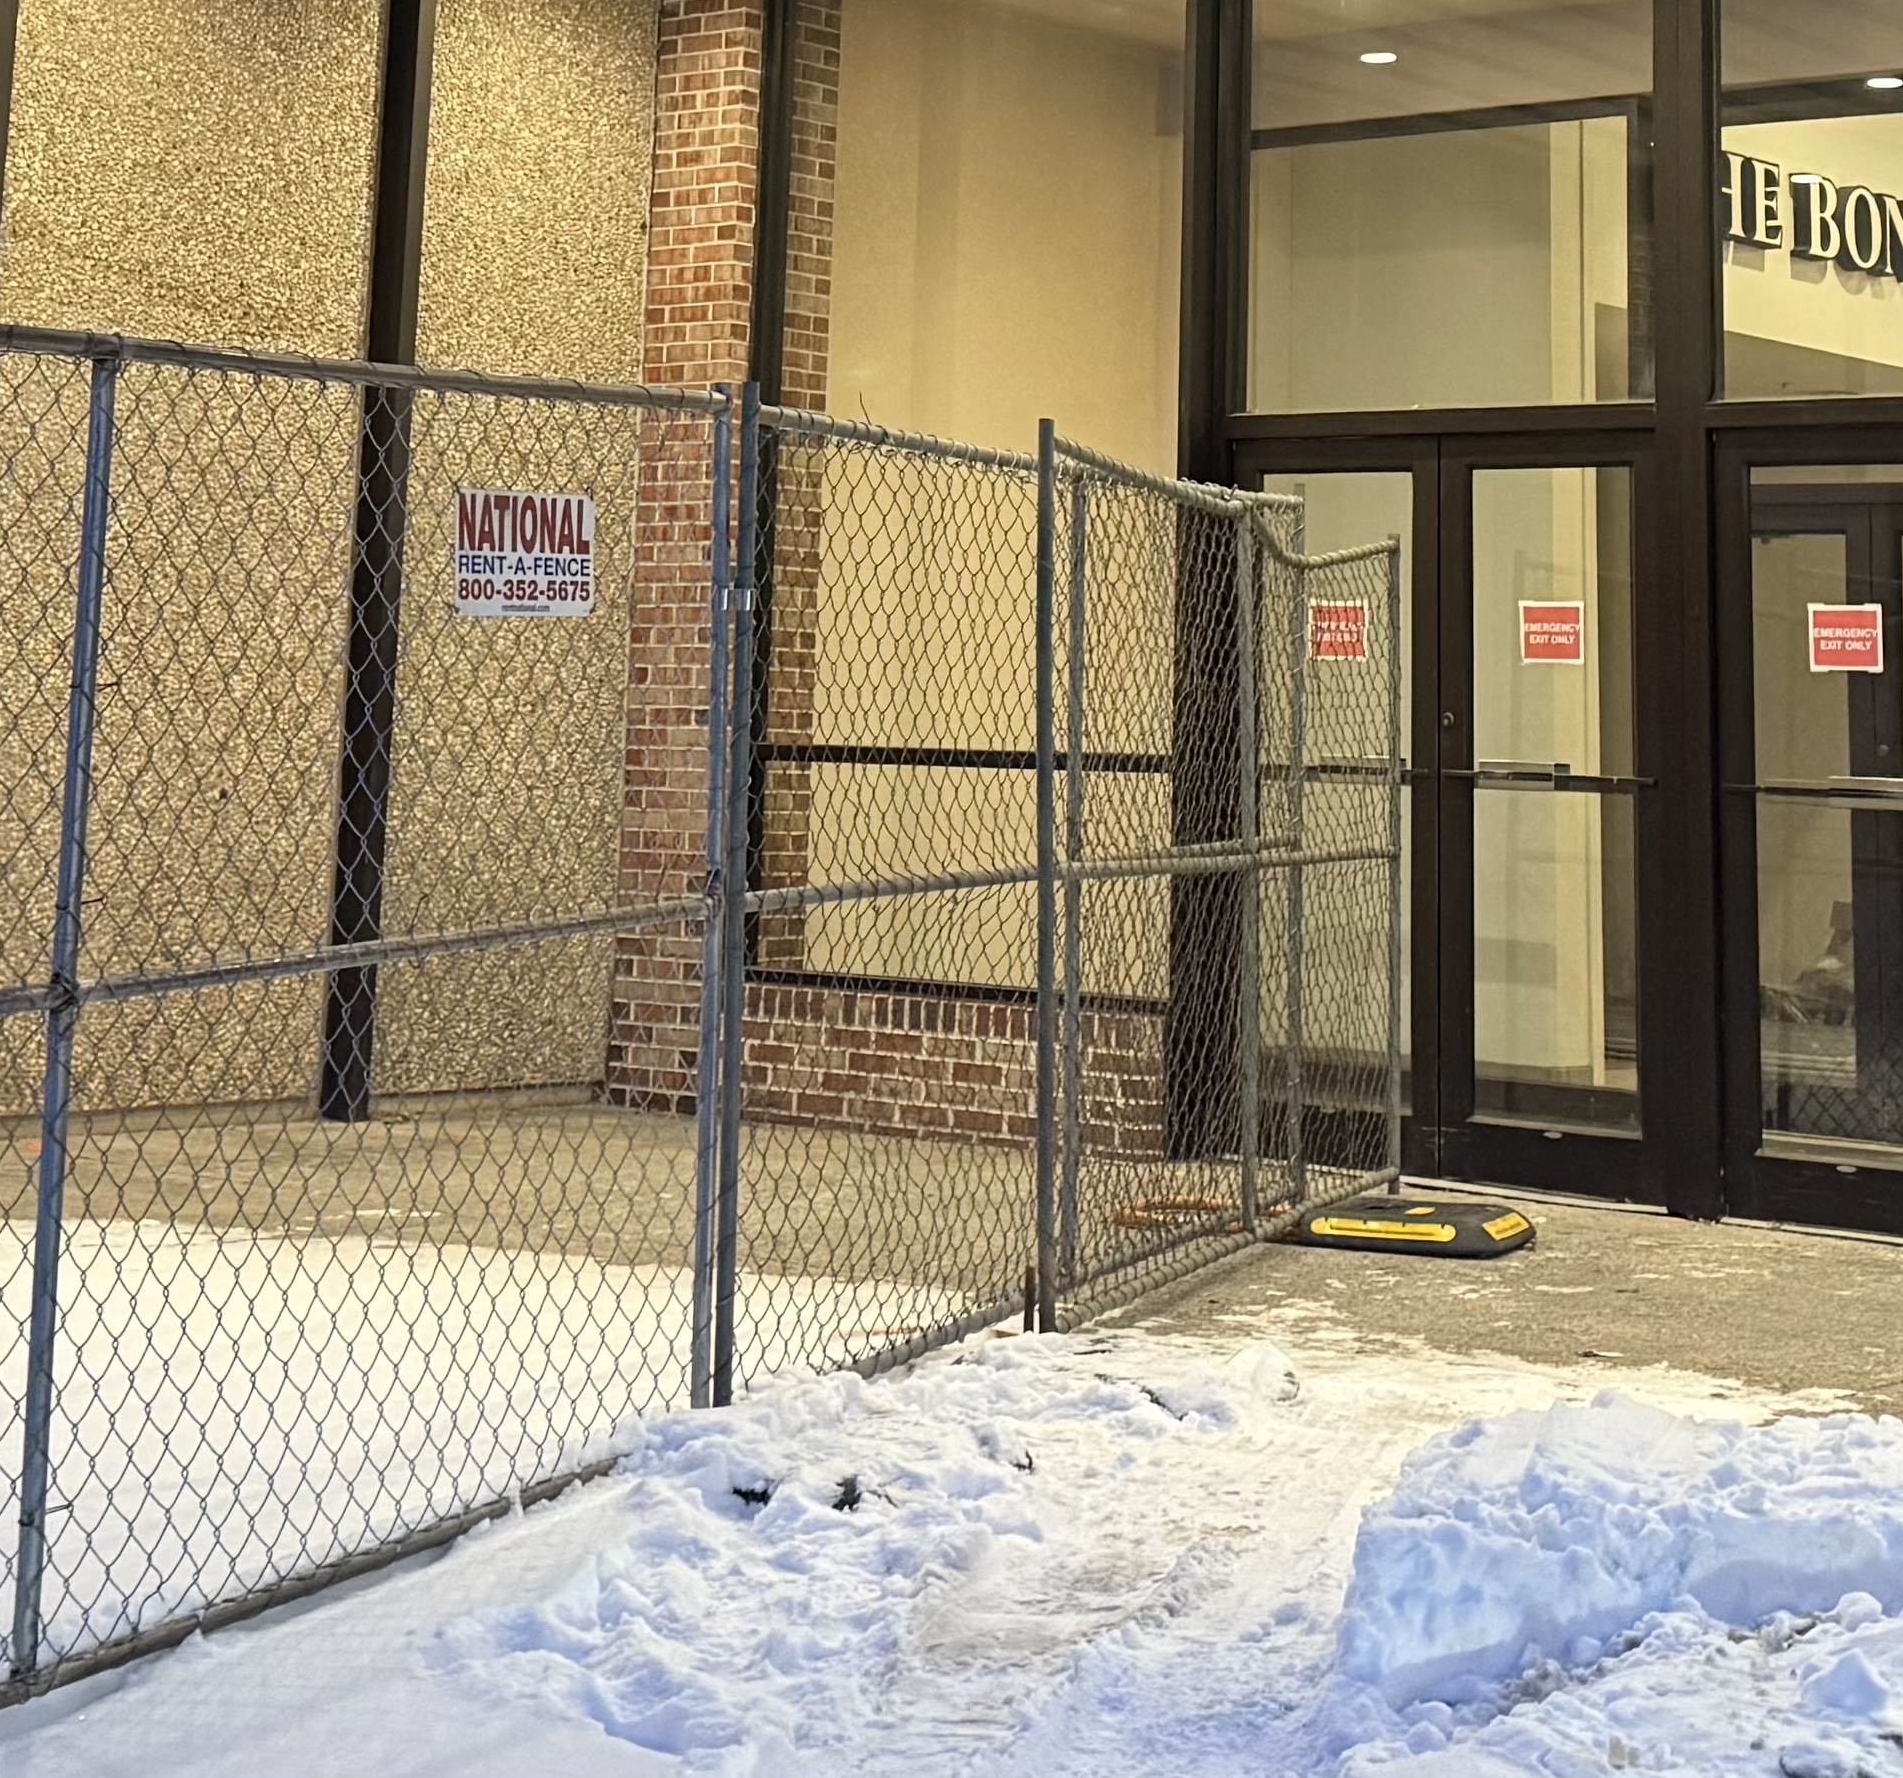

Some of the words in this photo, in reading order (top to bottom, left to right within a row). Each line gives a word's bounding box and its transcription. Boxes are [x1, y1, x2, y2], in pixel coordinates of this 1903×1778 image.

[459, 493, 590, 554] NATIONAL
[458, 554, 591, 577] RENT-A-FENCE
[458, 578, 590, 602] 800-352-5675
[1524, 622, 1580, 633] EMERGENCY
[1813, 627, 1878, 639] EMERGENCY
[1529, 633, 1549, 645] EXIT
[1550, 633, 1576, 645] ONLY
[1819, 639, 1843, 651] EXIT
[1844, 640, 1873, 651] ONLY
